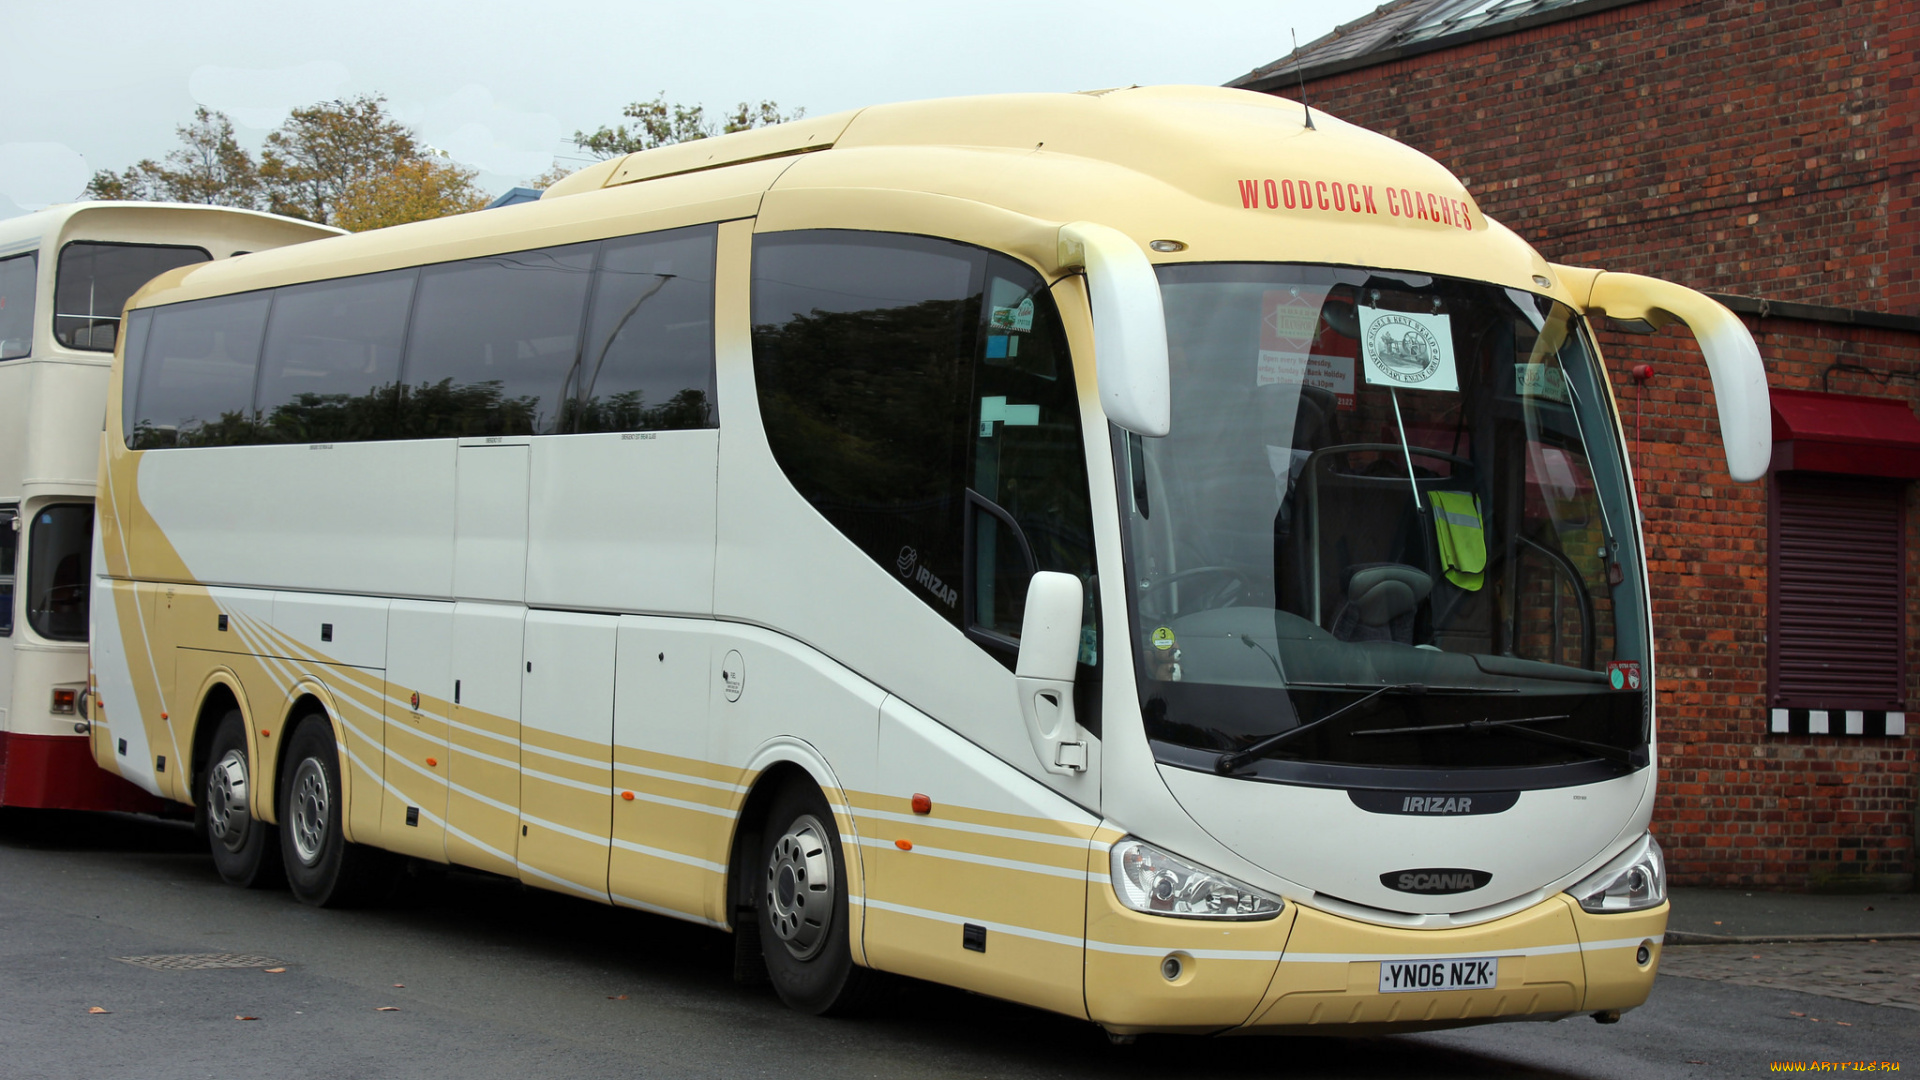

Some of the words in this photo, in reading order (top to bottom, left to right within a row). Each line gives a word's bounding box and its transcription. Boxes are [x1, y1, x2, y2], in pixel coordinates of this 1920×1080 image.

[1238, 178, 1378, 215] WOODCOCK
[1385, 186, 1473, 231] COACHES
[1393, 315, 1412, 327] KENT
[1414, 323, 1436, 348] WEALD
[1263, 354, 1281, 364] Open
[1282, 356, 1297, 366] every
[1369, 348, 1401, 381] STATIONARY
[1404, 371, 1428, 383] ENGINE
[1278, 366, 1299, 375] Sunday
[1307, 368, 1322, 377] Bank
[1323, 369, 1346, 379] Holiday
[1337, 397, 1354, 406] 2122
[915, 564, 958, 609] IRIZAR
[1159, 628, 1166, 639] 3
[1402, 796, 1472, 813] IRIZAR
[1397, 873, 1475, 890] SCANIA
[1390, 963, 1445, 988] YN06
[1449, 961, 1491, 986] NZK
